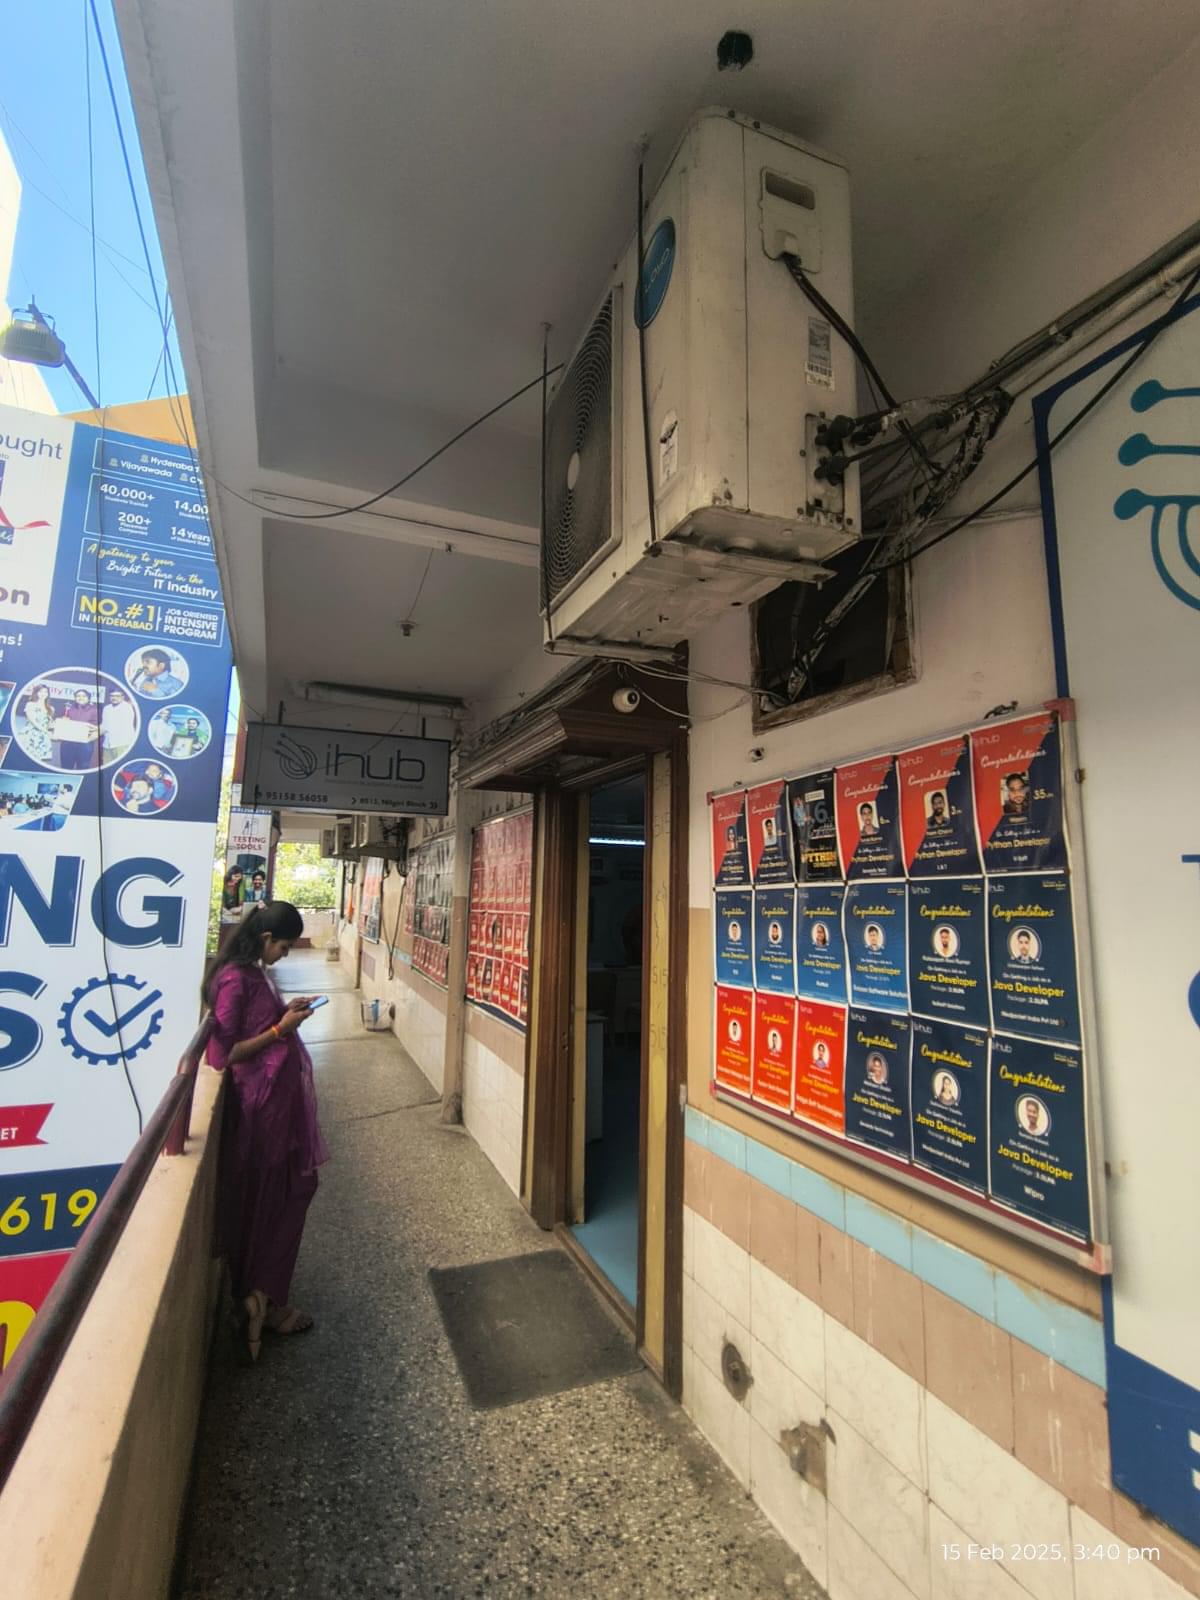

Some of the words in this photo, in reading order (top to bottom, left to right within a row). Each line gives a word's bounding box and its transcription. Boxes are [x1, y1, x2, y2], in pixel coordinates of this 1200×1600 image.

[0, 434, 62, 460] ught
[120, 460, 172, 477] Vijayawada
[100, 484, 156, 501] 40,000+
[118, 511, 152, 525] 200+
[87, 543, 97, 553] A
[141, 552, 151, 562] to
[106, 560, 143, 577] Bright
[154, 579, 164, 589] IT
[167, 581, 219, 600] Industry
[79, 613, 90, 622] IN
[93, 615, 153, 631] HYDERABAD
[164, 615, 218, 631] INTENSIVE
[163, 625, 217, 640] PROGRAM
[325, 743, 426, 783] ihub
[980, 748, 1046, 768] Congratulations
[908, 770, 961, 786] Congratulations
[233, 835, 266, 844] TESTING
[236, 843, 262, 851] TOOLS
[1013, 838, 1050, 848] Developer
[920, 904, 972, 921] Congratulations
[992, 904, 1055, 922] Congratulations
[918, 971, 937, 982] Java
[937, 973, 977, 988] Developer
[993, 980, 1014, 991] Java
[1015, 982, 1065, 998] Developer
[857, 1031, 897, 1050] Congratulations
[921, 1044, 973, 1068] Congratulations
[999, 1065, 1066, 1093] Congratulations
[852, 1093, 869, 1105] Java
[869, 1096, 902, 1116] Developer
[1, 1127, 18, 1140] ET
[916, 1113, 935, 1127] Java
[936, 1120, 976, 1144] Developer
[998, 1144, 1020, 1160] Java
[1022, 1152, 1073, 1181] Developer
[0, 1189, 97, 1236] 619
